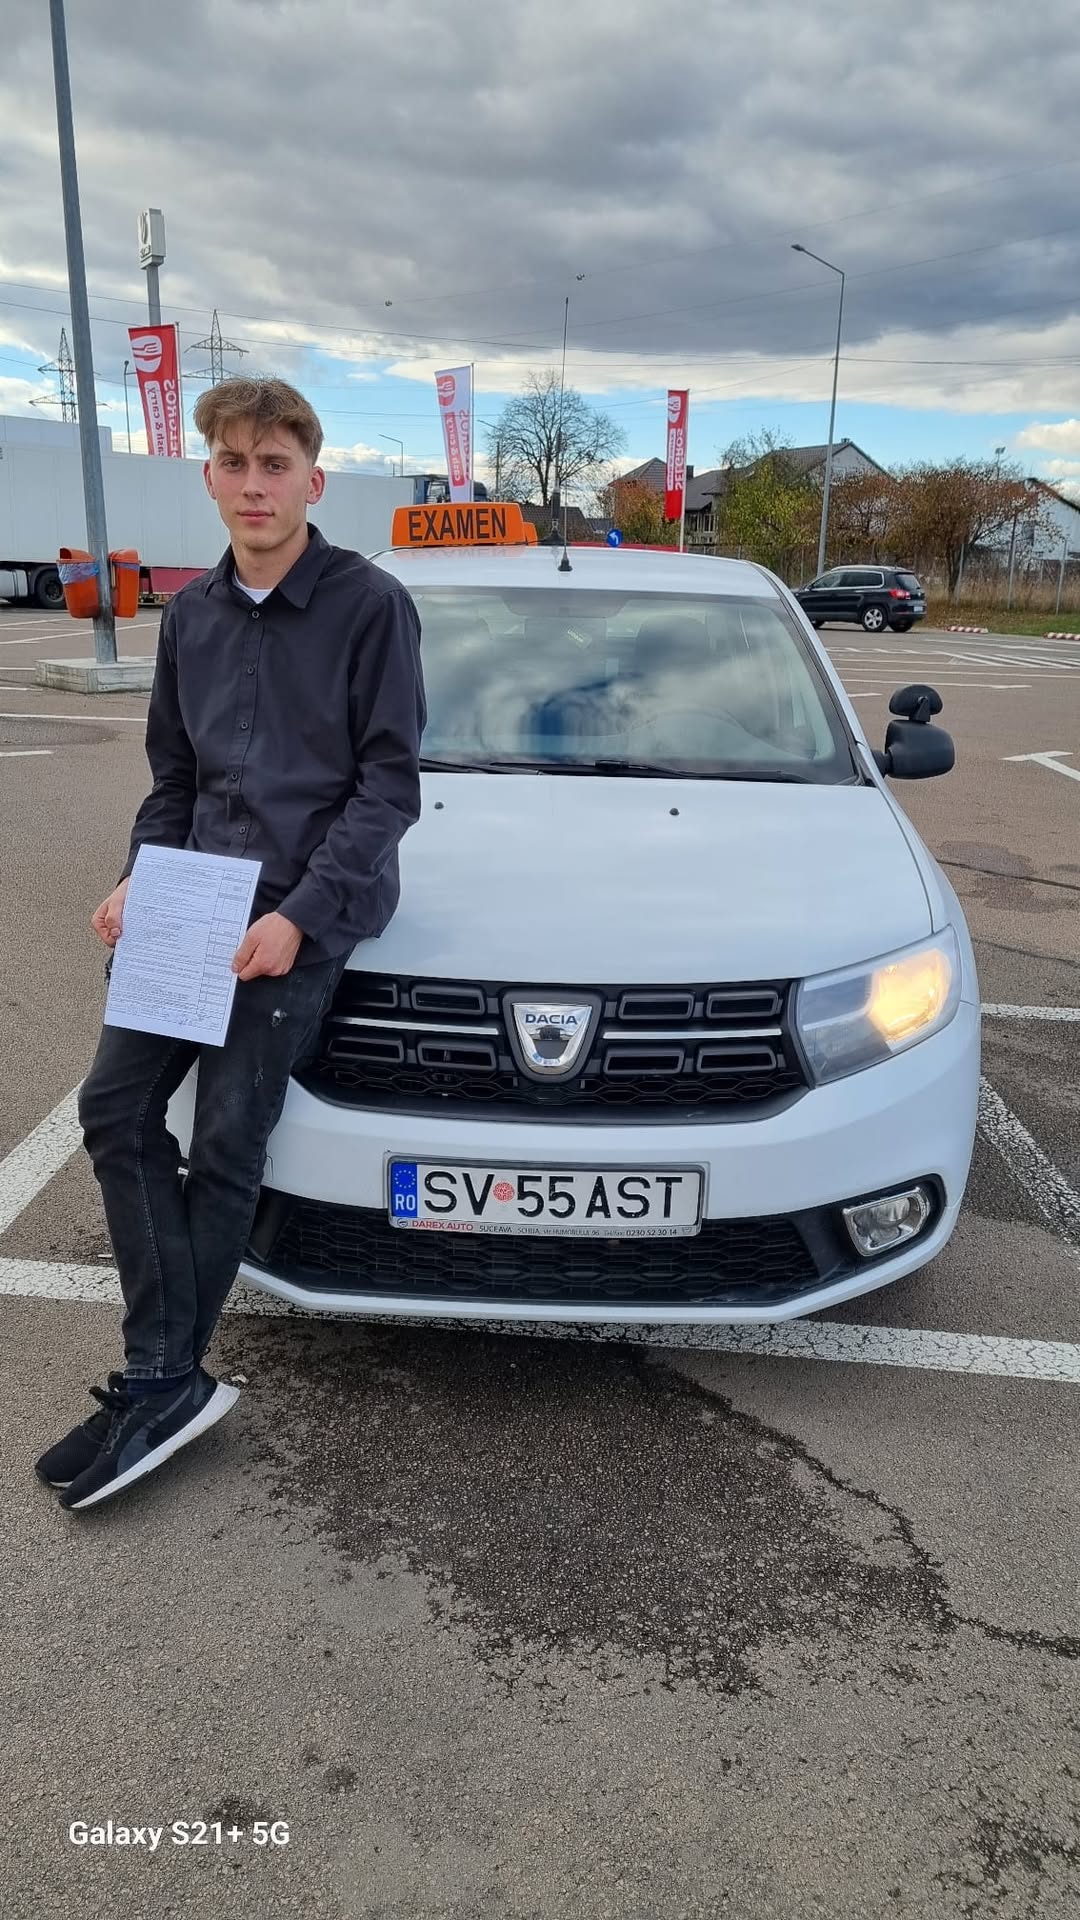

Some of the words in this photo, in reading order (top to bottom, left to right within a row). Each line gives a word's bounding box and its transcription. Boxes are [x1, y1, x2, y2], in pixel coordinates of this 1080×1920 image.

[408, 507, 507, 541] EXAMEN
[525, 1013, 578, 1025] DACIA
[395, 1193, 416, 1211] RO
[424, 1171, 494, 1215] SV
[516, 1174, 575, 1218] 55
[585, 1175, 683, 1219] AST
[411, 1220, 444, 1229] DAREX
[446, 1222, 474, 1231] AUTO
[479, 1225, 512, 1233] SUCEAVA
